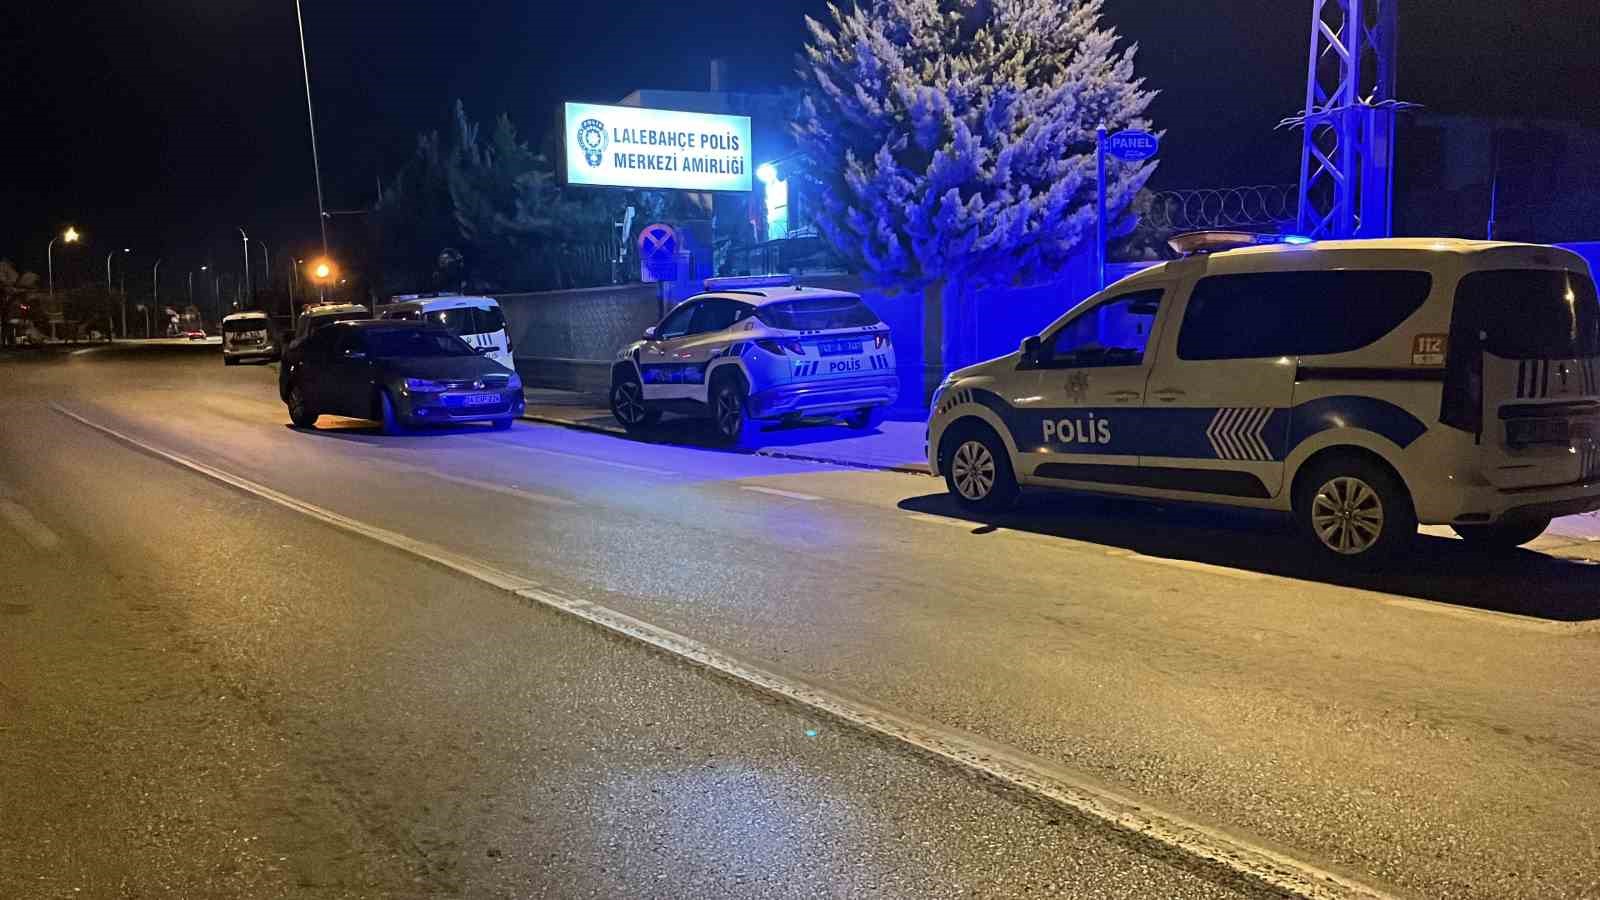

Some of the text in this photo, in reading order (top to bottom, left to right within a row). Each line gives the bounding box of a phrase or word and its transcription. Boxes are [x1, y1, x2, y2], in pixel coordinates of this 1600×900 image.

[613, 127, 695, 151] LALEBAHÇE
[701, 131, 740, 151] POLİS
[1112, 137, 1153, 148] PANEL
[614, 152, 744, 175] MERKEZİ AMİRLİĞİ
[1419, 337, 1441, 352] 112
[830, 357, 861, 372] POLİS
[1042, 412, 1111, 444] POLİS
